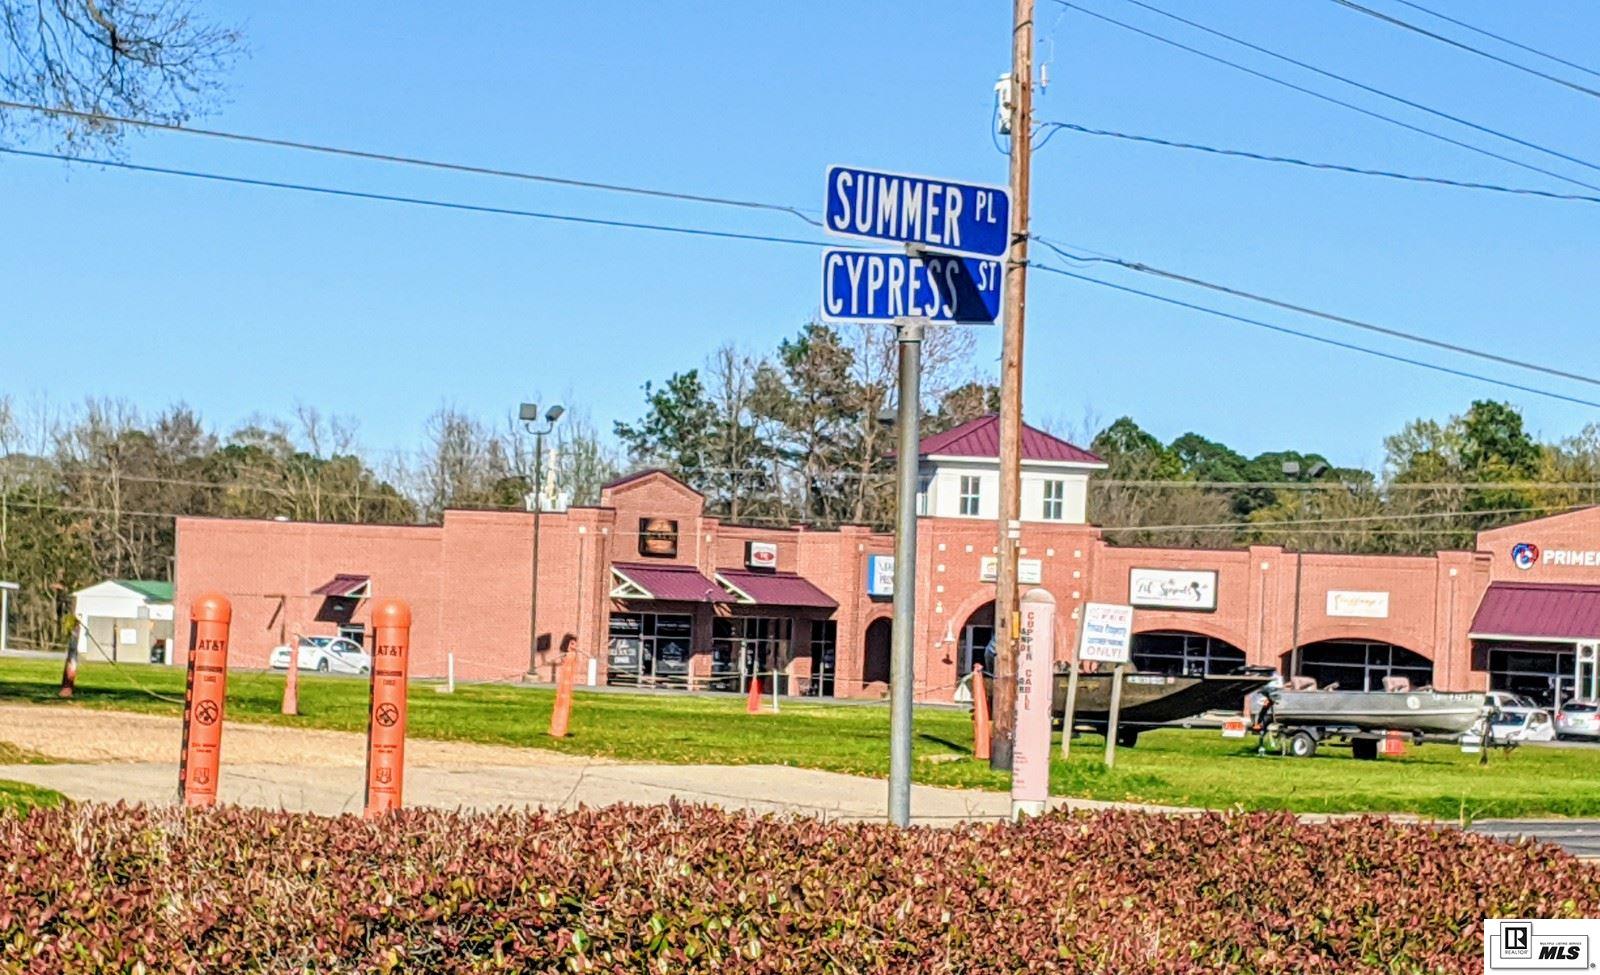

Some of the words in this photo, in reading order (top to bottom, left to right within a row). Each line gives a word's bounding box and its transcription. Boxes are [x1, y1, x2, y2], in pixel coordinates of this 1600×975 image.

[834, 171, 963, 246] SUMMER
[975, 191, 997, 224] PL
[826, 253, 960, 318] CYPRESS
[977, 261, 997, 291] ST
[198, 639, 225, 652] AT&T
[376, 645, 403, 657] AT&T
